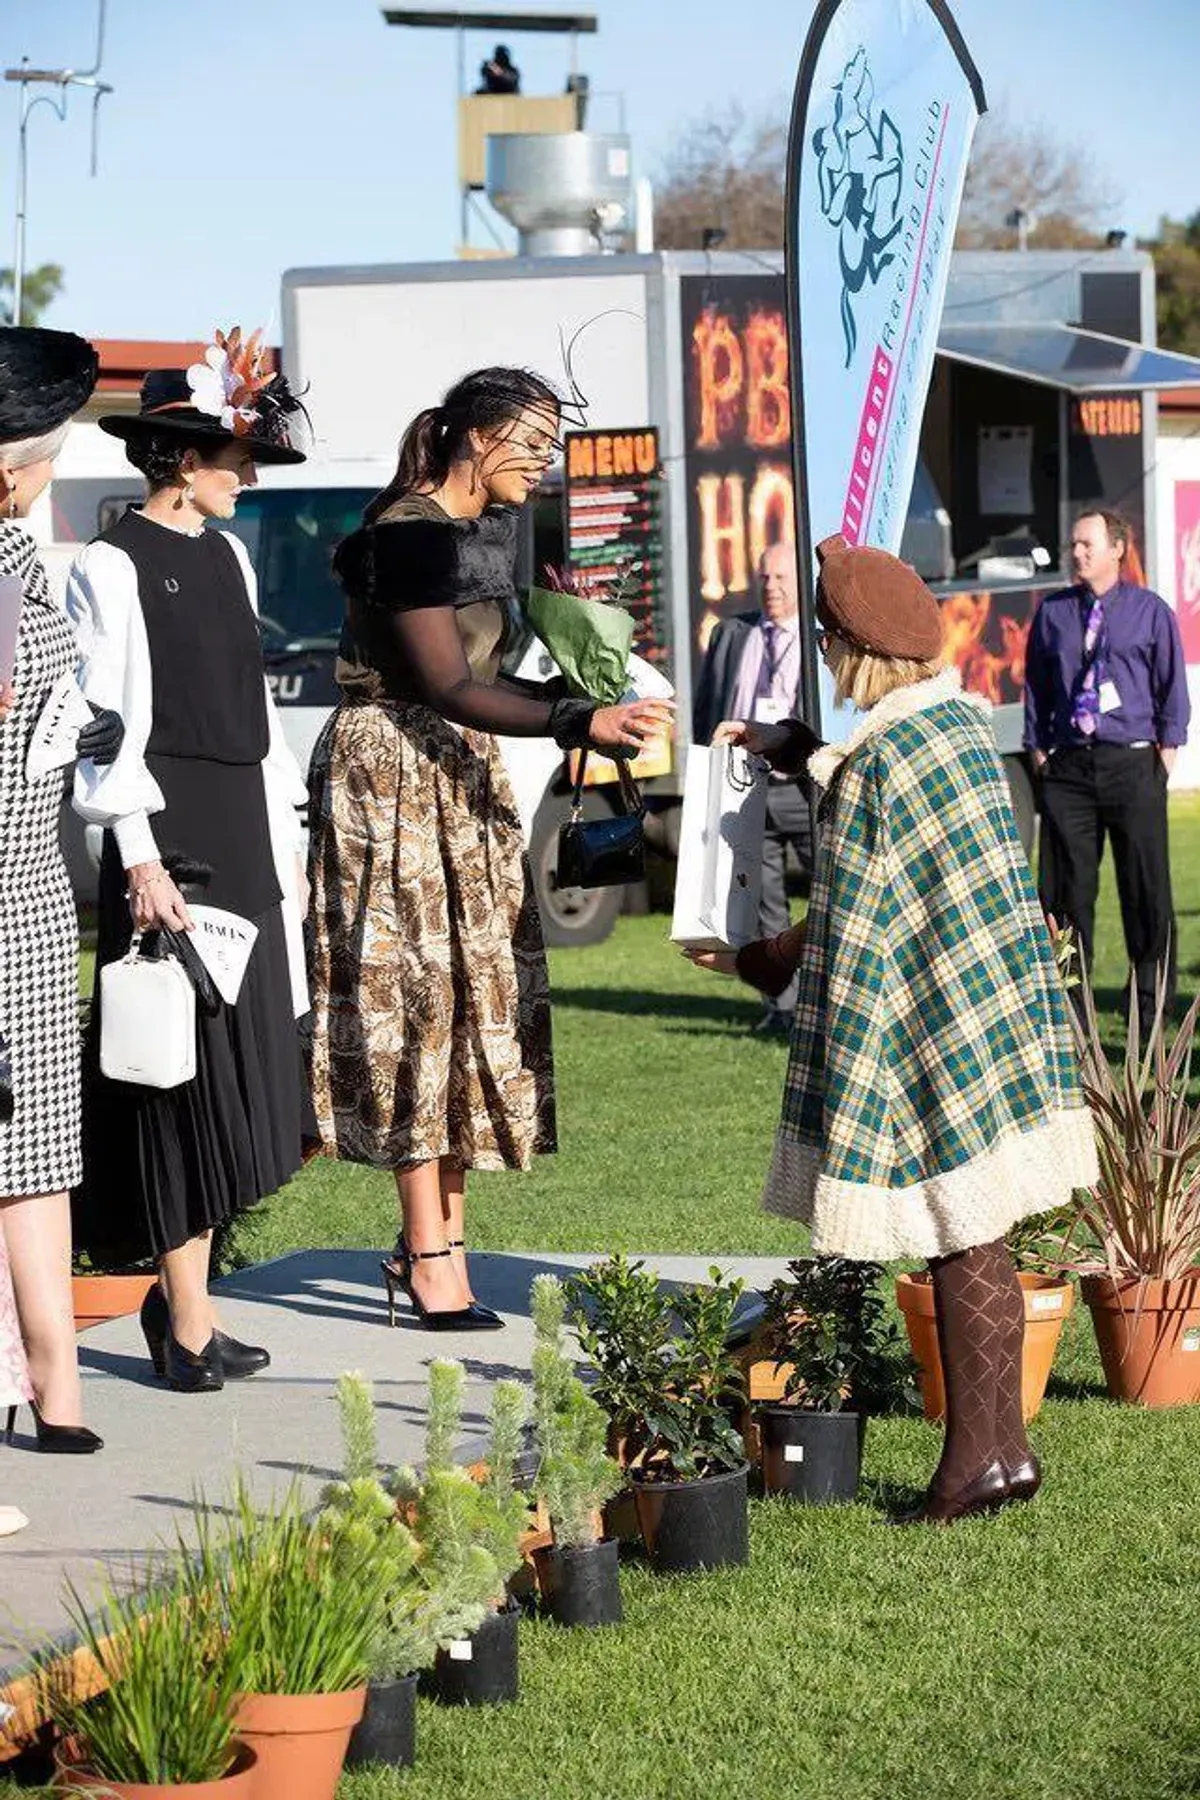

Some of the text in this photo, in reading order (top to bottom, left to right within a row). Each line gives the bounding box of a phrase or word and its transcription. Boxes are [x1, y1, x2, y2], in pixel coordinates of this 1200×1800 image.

[882, 206, 921, 349] Racing
[914, 100, 941, 187] Club
[569, 433, 656, 478] MENU
